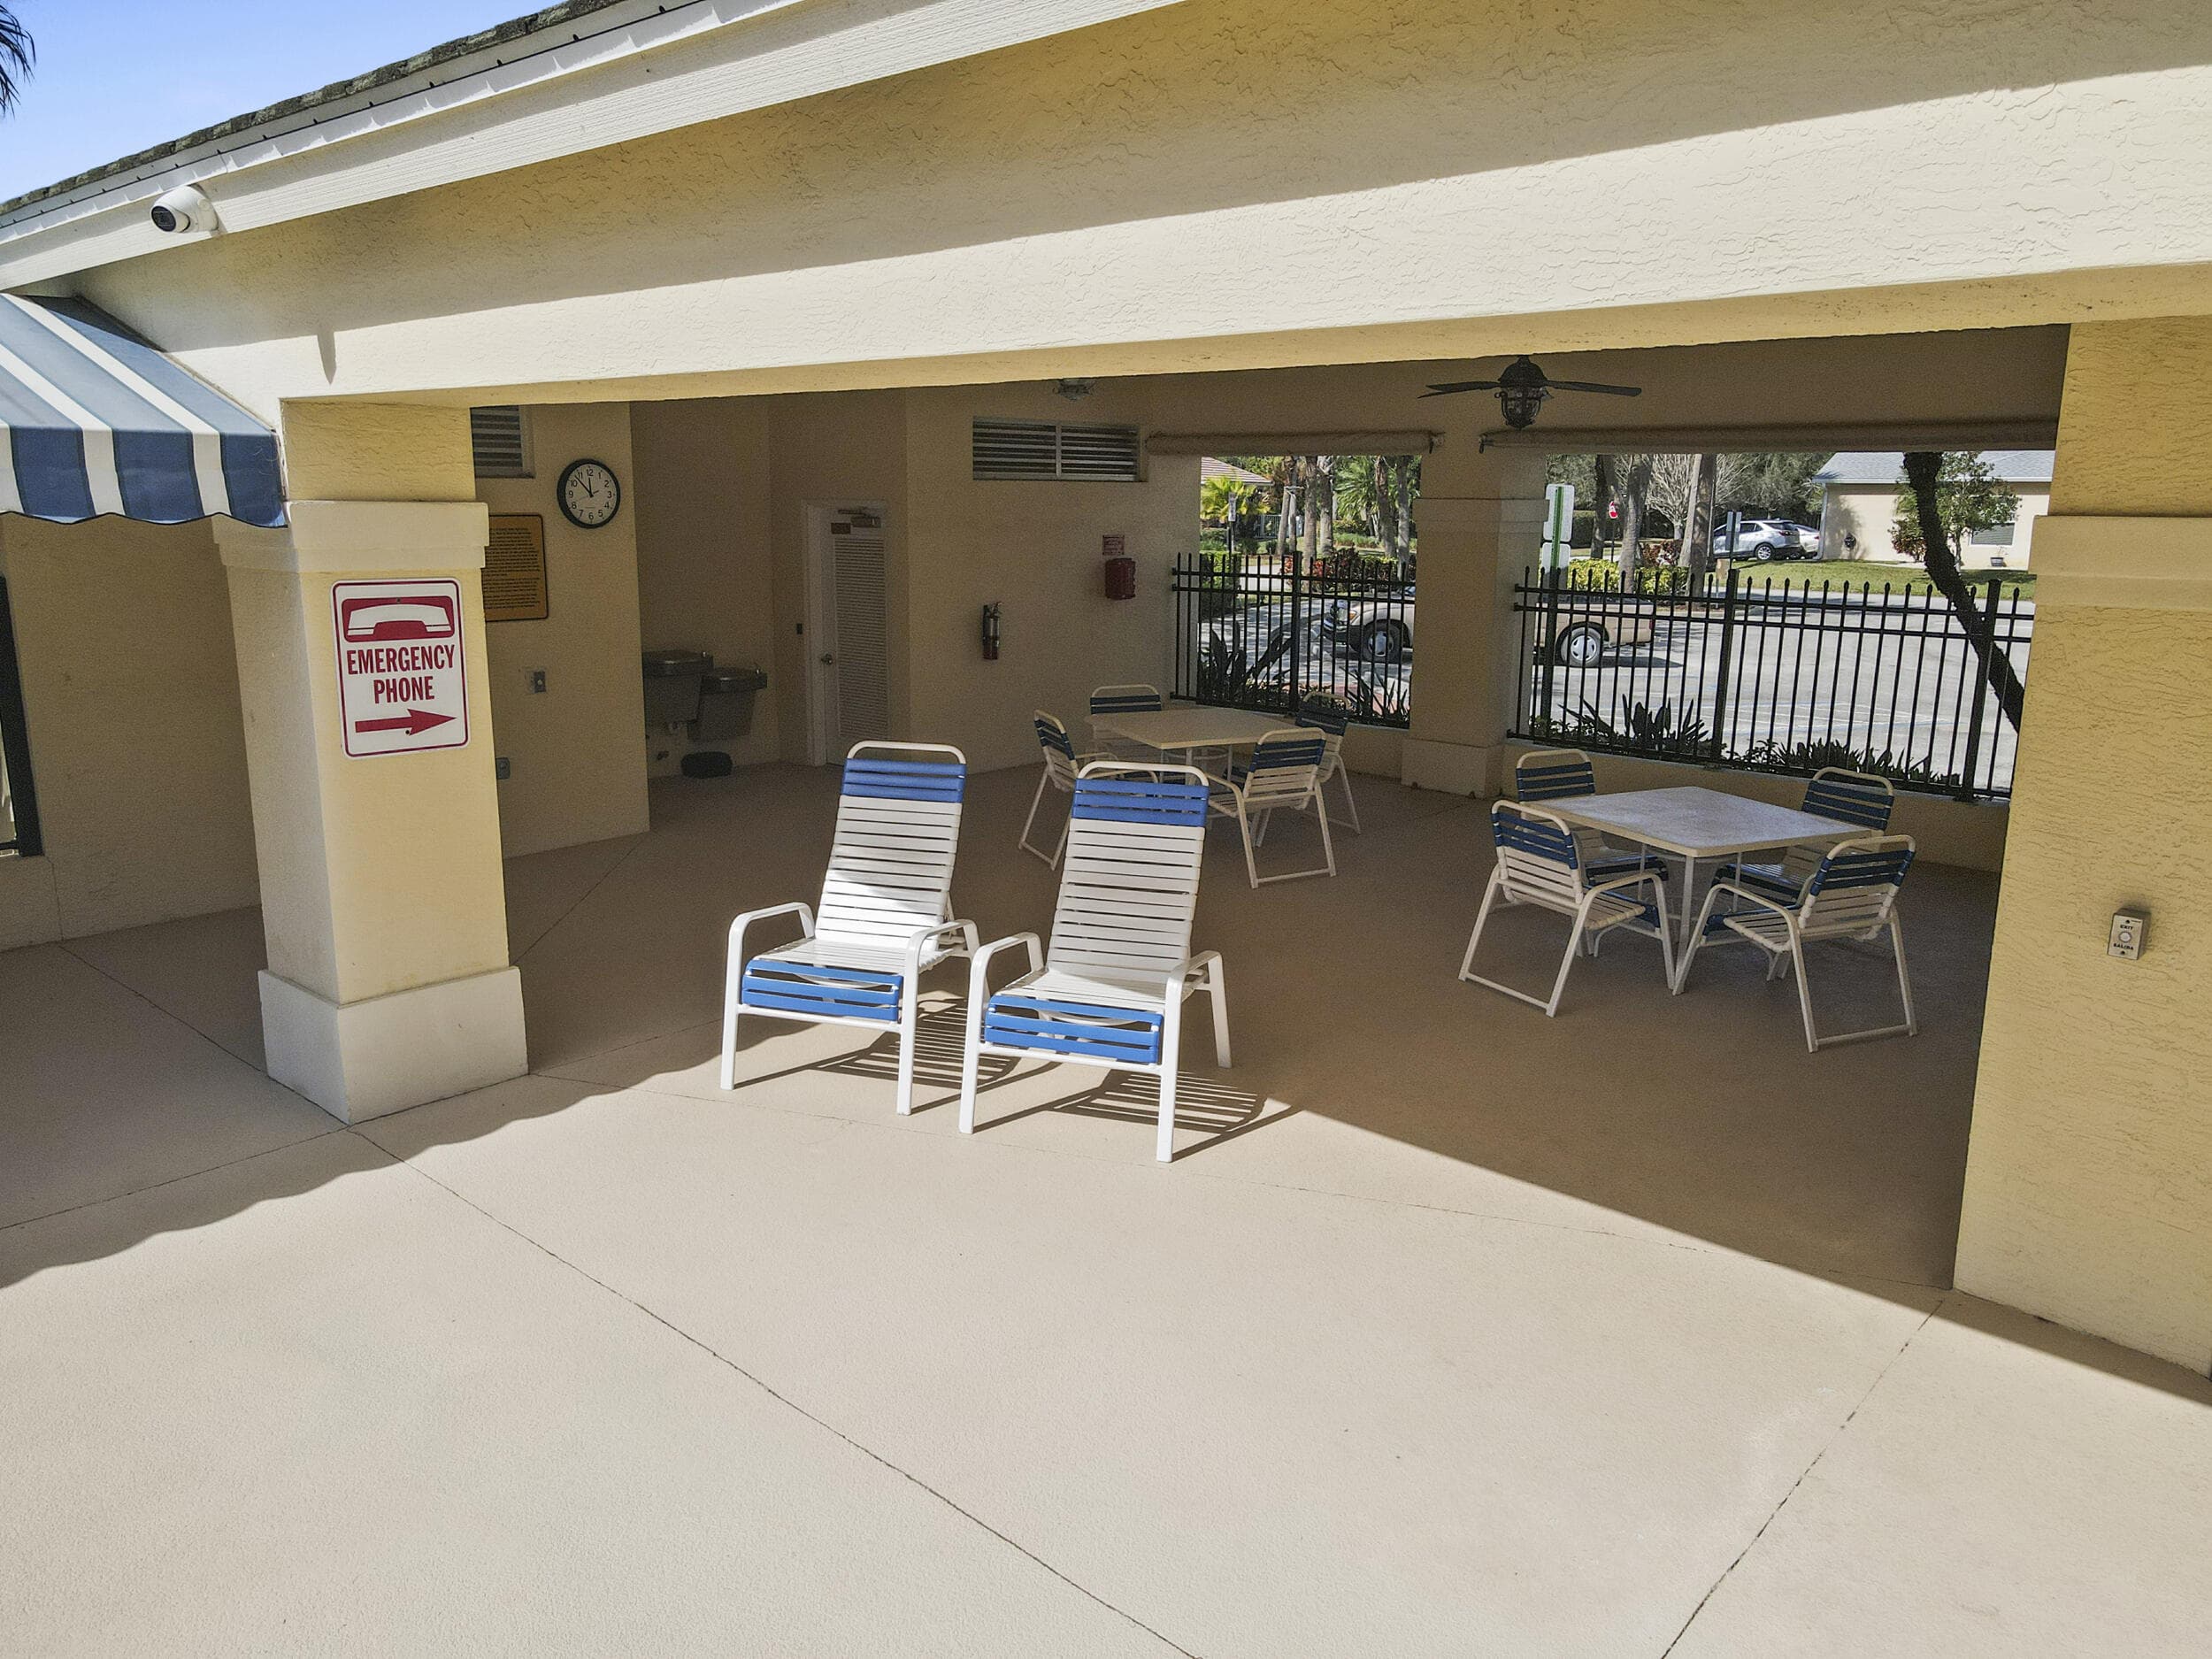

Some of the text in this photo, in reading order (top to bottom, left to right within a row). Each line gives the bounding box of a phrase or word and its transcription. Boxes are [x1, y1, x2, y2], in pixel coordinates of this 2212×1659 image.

[598, 509, 603, 518] 5
[346, 644, 455, 675] EMERGENCY
[373, 676, 434, 703] PHONE
